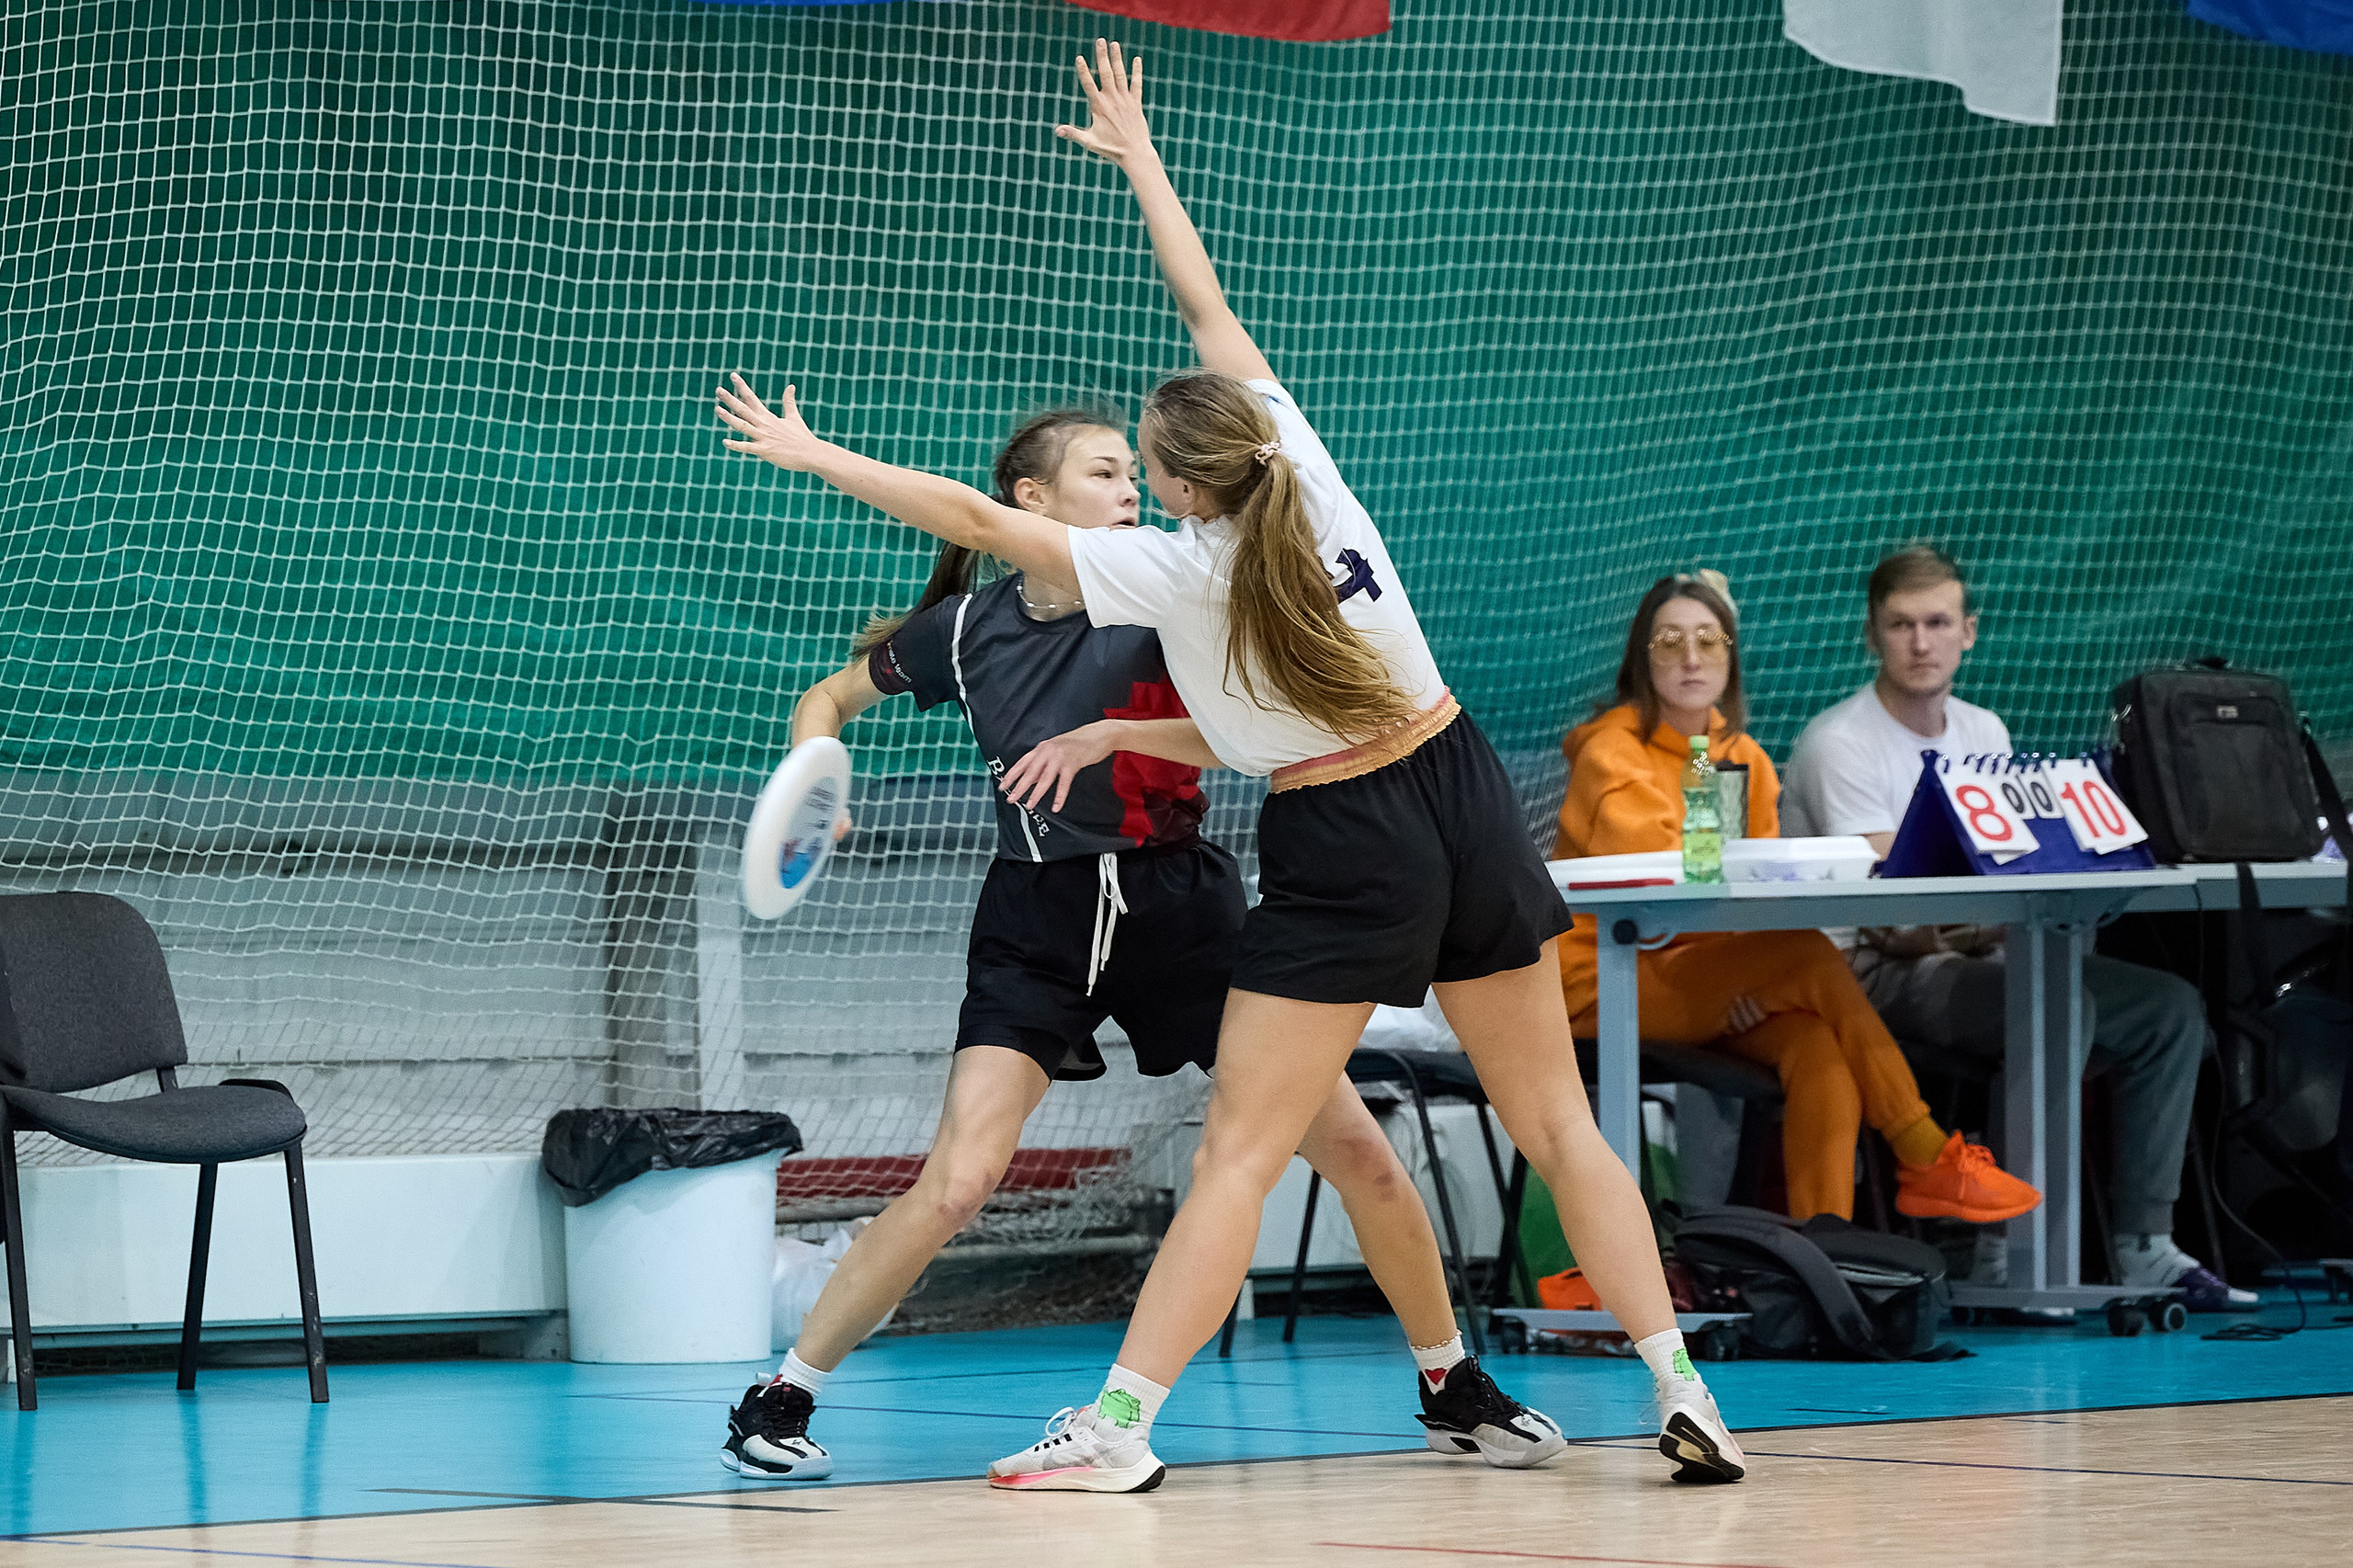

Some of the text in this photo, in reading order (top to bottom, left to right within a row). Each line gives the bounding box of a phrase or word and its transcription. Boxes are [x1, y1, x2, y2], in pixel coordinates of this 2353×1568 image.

[894, 664, 912, 683] team
[1955, 784, 2013, 841] 8
[2060, 780, 2127, 838] 10
